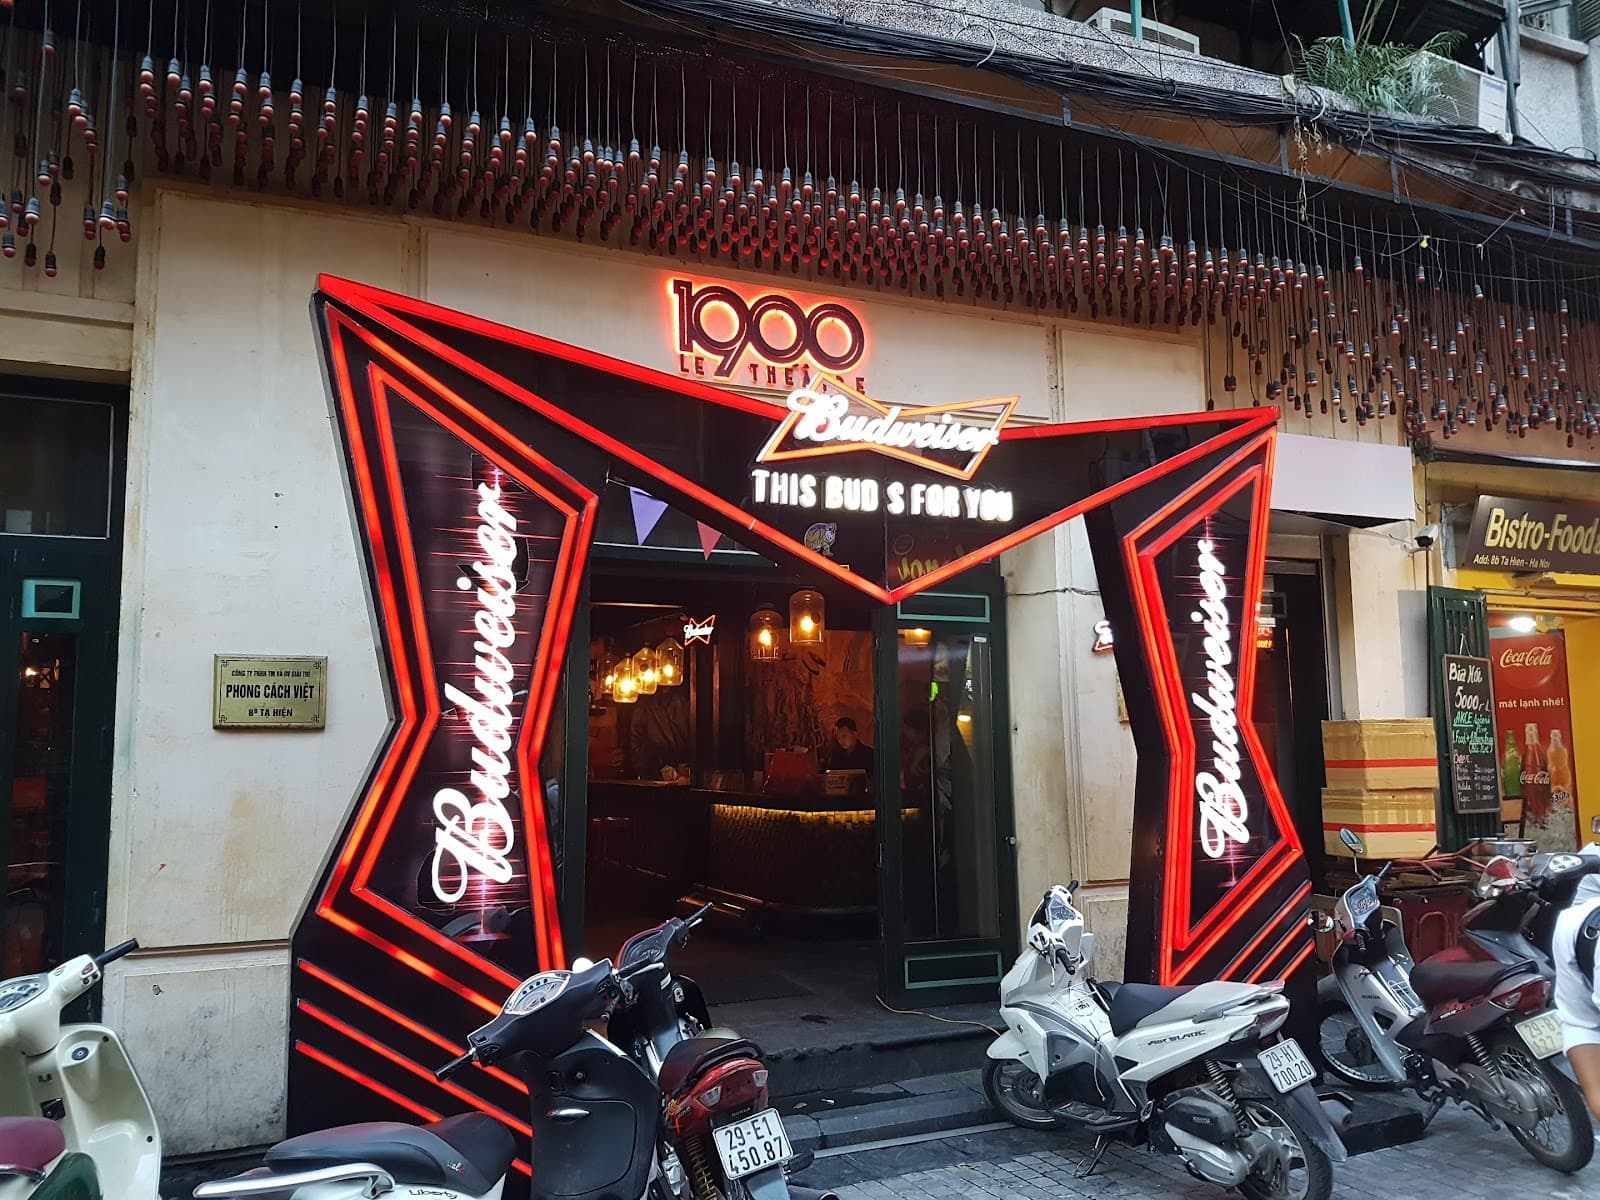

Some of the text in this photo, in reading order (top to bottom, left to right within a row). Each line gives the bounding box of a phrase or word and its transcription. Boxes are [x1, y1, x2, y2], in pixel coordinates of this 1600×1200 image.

[673, 279, 866, 377] 1900
[680, 354, 865, 395] LE THÉÂE
[787, 387, 999, 452] Budweiser
[751, 469, 817, 508] THIS
[910, 483, 960, 518] FOR
[964, 489, 1014, 522] YOU
[1473, 554, 1490, 565] Add:
[1501, 555, 1509, 566] Ta
[1529, 557, 1538, 568] Ha
[1449, 662, 1466, 681] Bia
[1500, 646, 1554, 668] Coca-Cola
[226, 682, 314, 702] PHONG CÁCH VIỆT
[432, 482, 518, 903] Budweiser
[1191, 539, 1249, 858] Budweiser
[1499, 697, 1564, 709] mát lạnh nhé!
[1520, 771, 1549, 785] Coca-Cola
[1266, 1044, 1297, 1070] 29-H1
[1273, 1060, 1311, 1089] 700.20
[724, 1116, 773, 1151] 29-E1
[728, 1136, 783, 1174] 450.87
